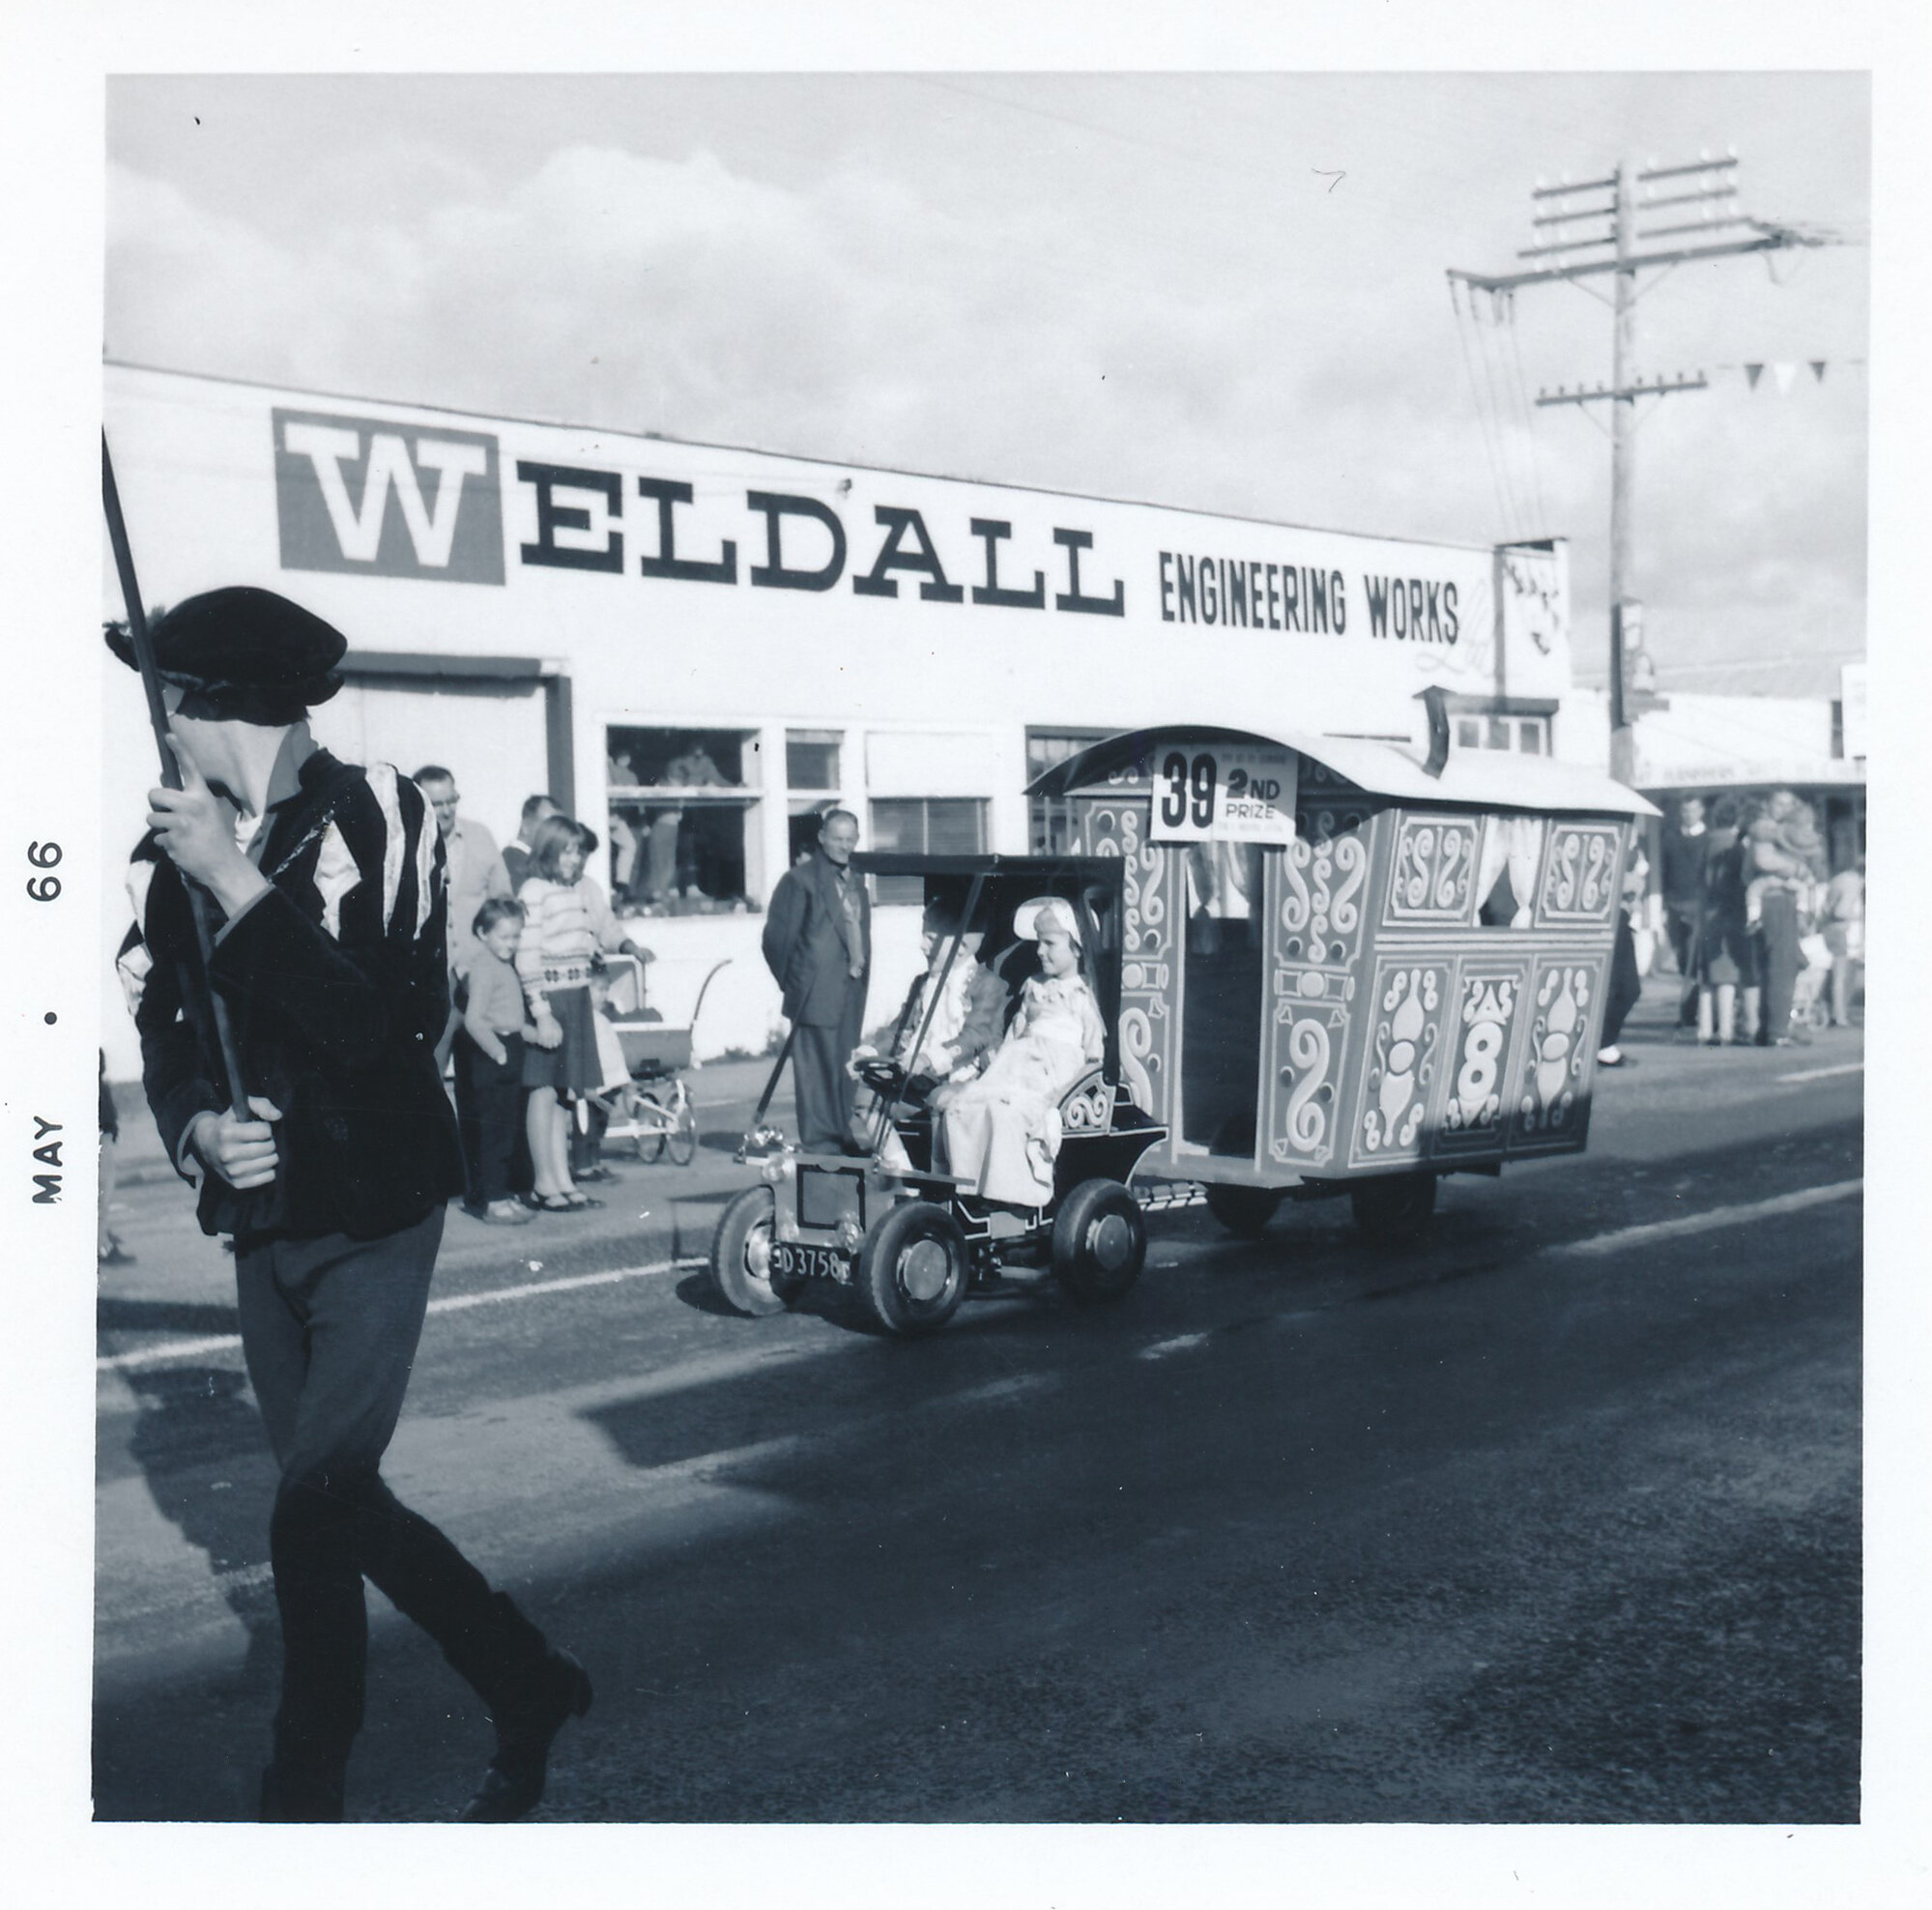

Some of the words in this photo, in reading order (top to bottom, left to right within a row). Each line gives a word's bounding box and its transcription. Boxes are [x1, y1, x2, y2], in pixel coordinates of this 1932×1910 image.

[284, 422, 1126, 617] WELDALL
[1159, 550, 1347, 635] ENGINEERING
[1364, 573, 1459, 646] WORKS
[1162, 751, 1218, 829] 39
[1226, 768, 1281, 800] 2ND
[1226, 803, 1276, 820] PRIZE
